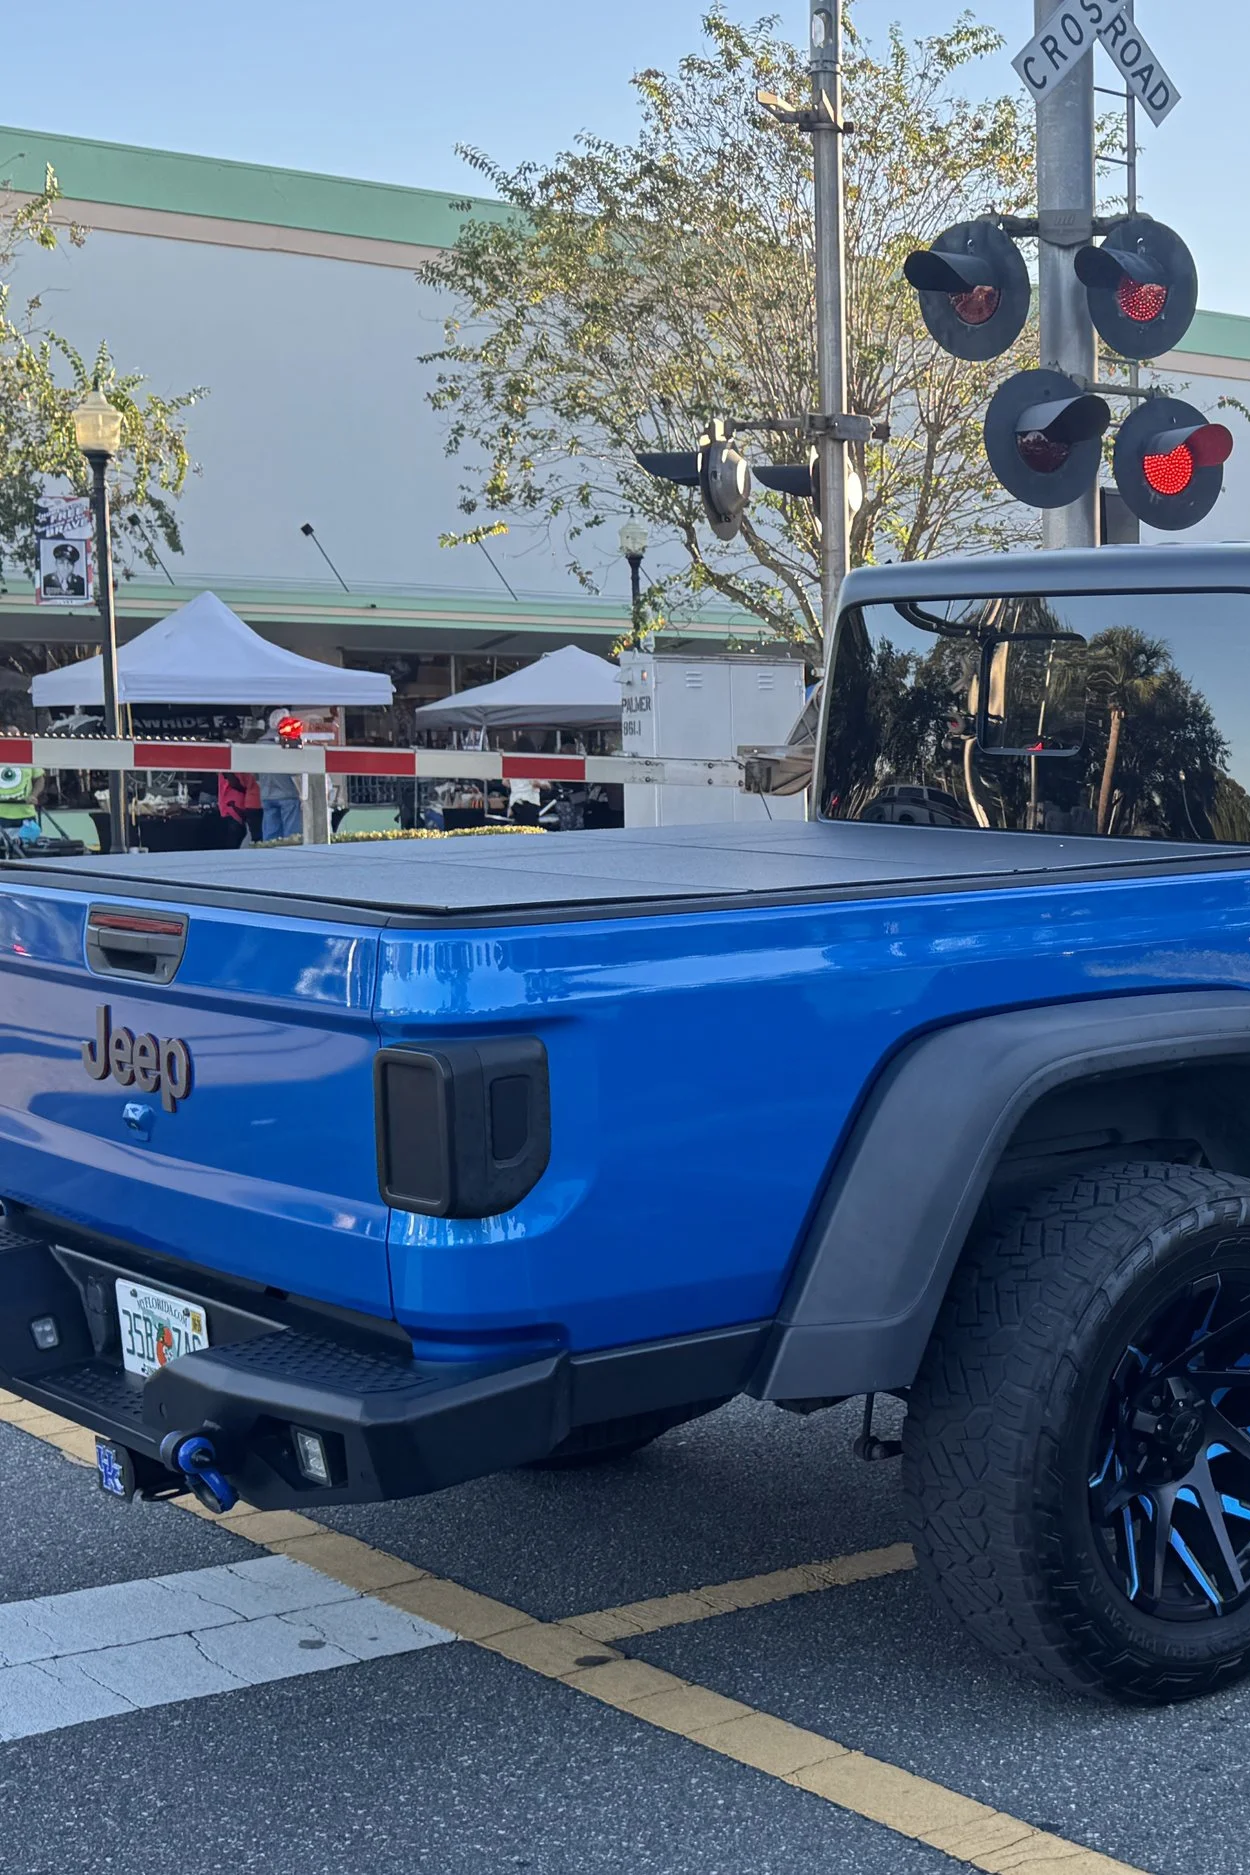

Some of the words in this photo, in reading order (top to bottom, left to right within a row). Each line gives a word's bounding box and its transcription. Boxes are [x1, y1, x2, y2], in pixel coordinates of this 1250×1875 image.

[1023, 0, 1118, 90] CROS
[1103, 13, 1169, 111] ROAD
[622, 696, 651, 713] PALMER
[81, 1003, 193, 1113] Jeep
[121, 1309, 155, 1363] 35B
